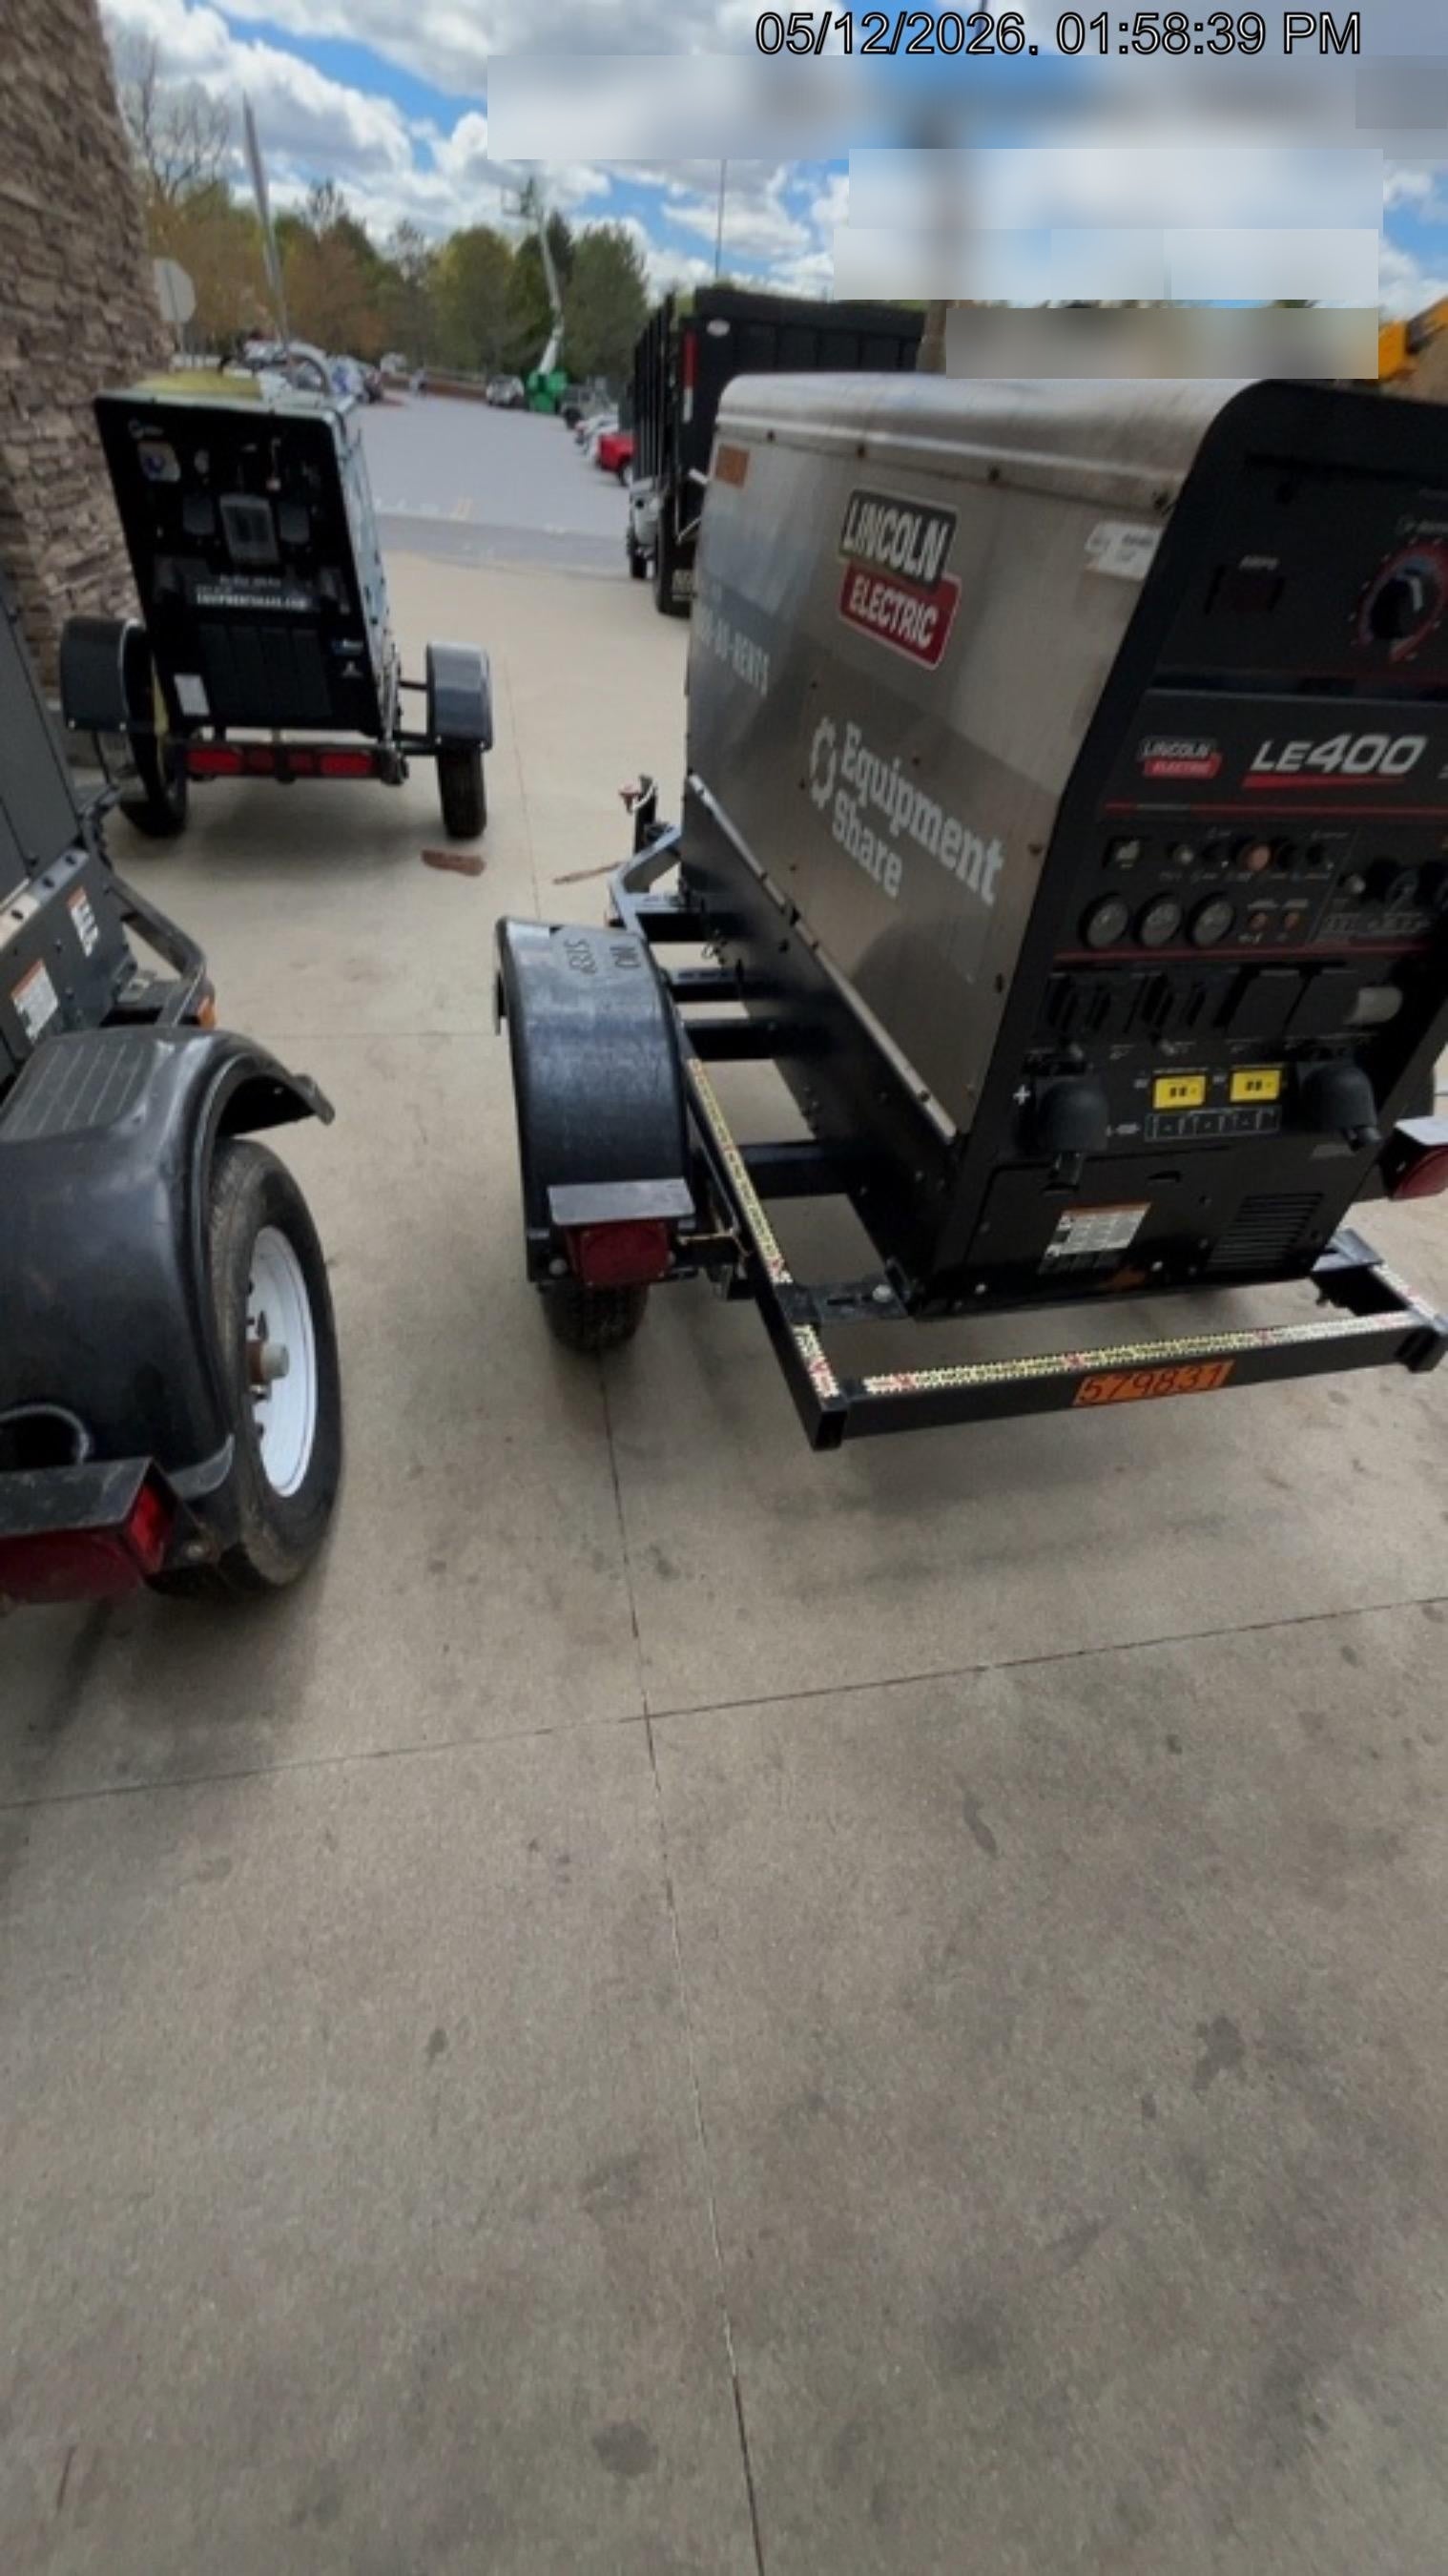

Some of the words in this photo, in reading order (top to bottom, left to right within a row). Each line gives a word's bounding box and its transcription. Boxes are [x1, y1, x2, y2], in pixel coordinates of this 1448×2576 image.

[843, 498, 950, 583] LINCOLN
[849, 574, 939, 649] ELECTRIC
[1250, 732, 1428, 775] LE400
[832, 789, 901, 899] Share
[841, 720, 1004, 905] Equipment
[1080, 1363, 1224, 1402] 579831
